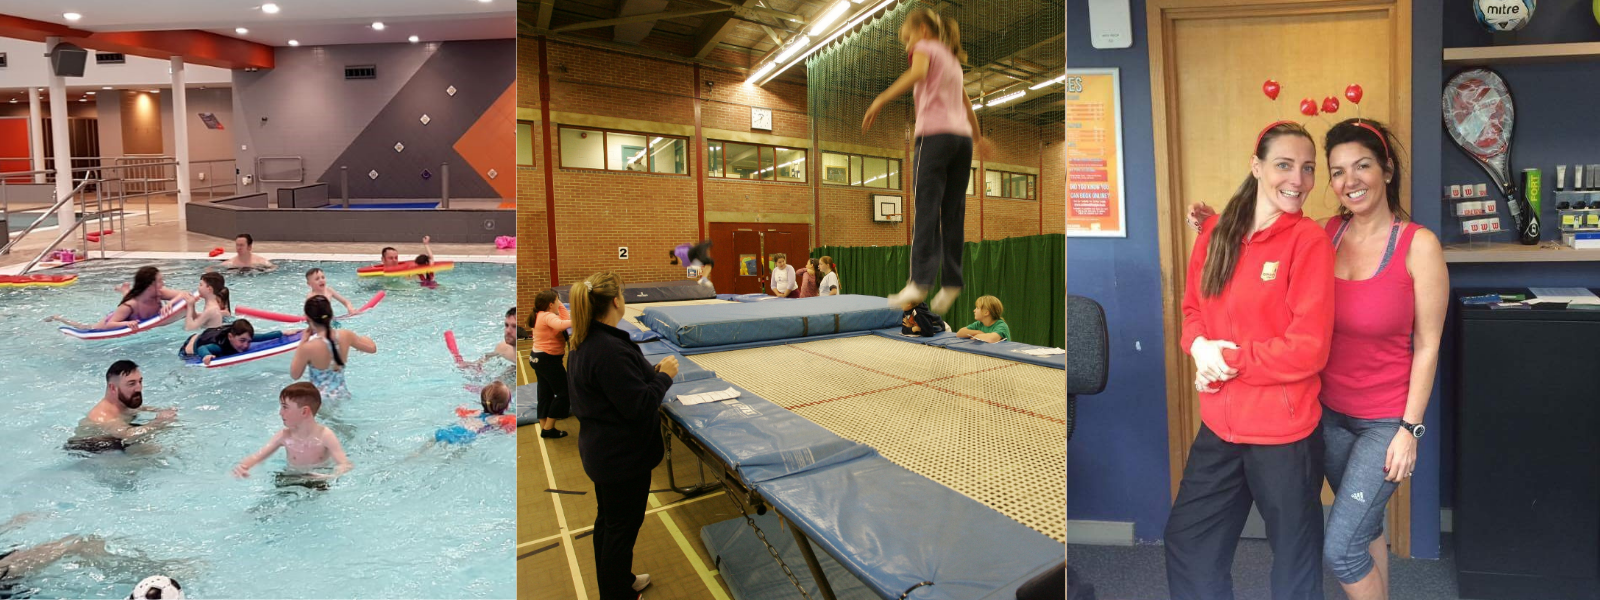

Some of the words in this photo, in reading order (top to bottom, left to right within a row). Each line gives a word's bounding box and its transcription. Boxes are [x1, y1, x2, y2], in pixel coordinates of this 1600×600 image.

[1488, 4, 1519, 14] mitre
[1067, 77, 1083, 93] ES
[1531, 175, 1539, 202] FORT
[620, 248, 627, 257] 2
